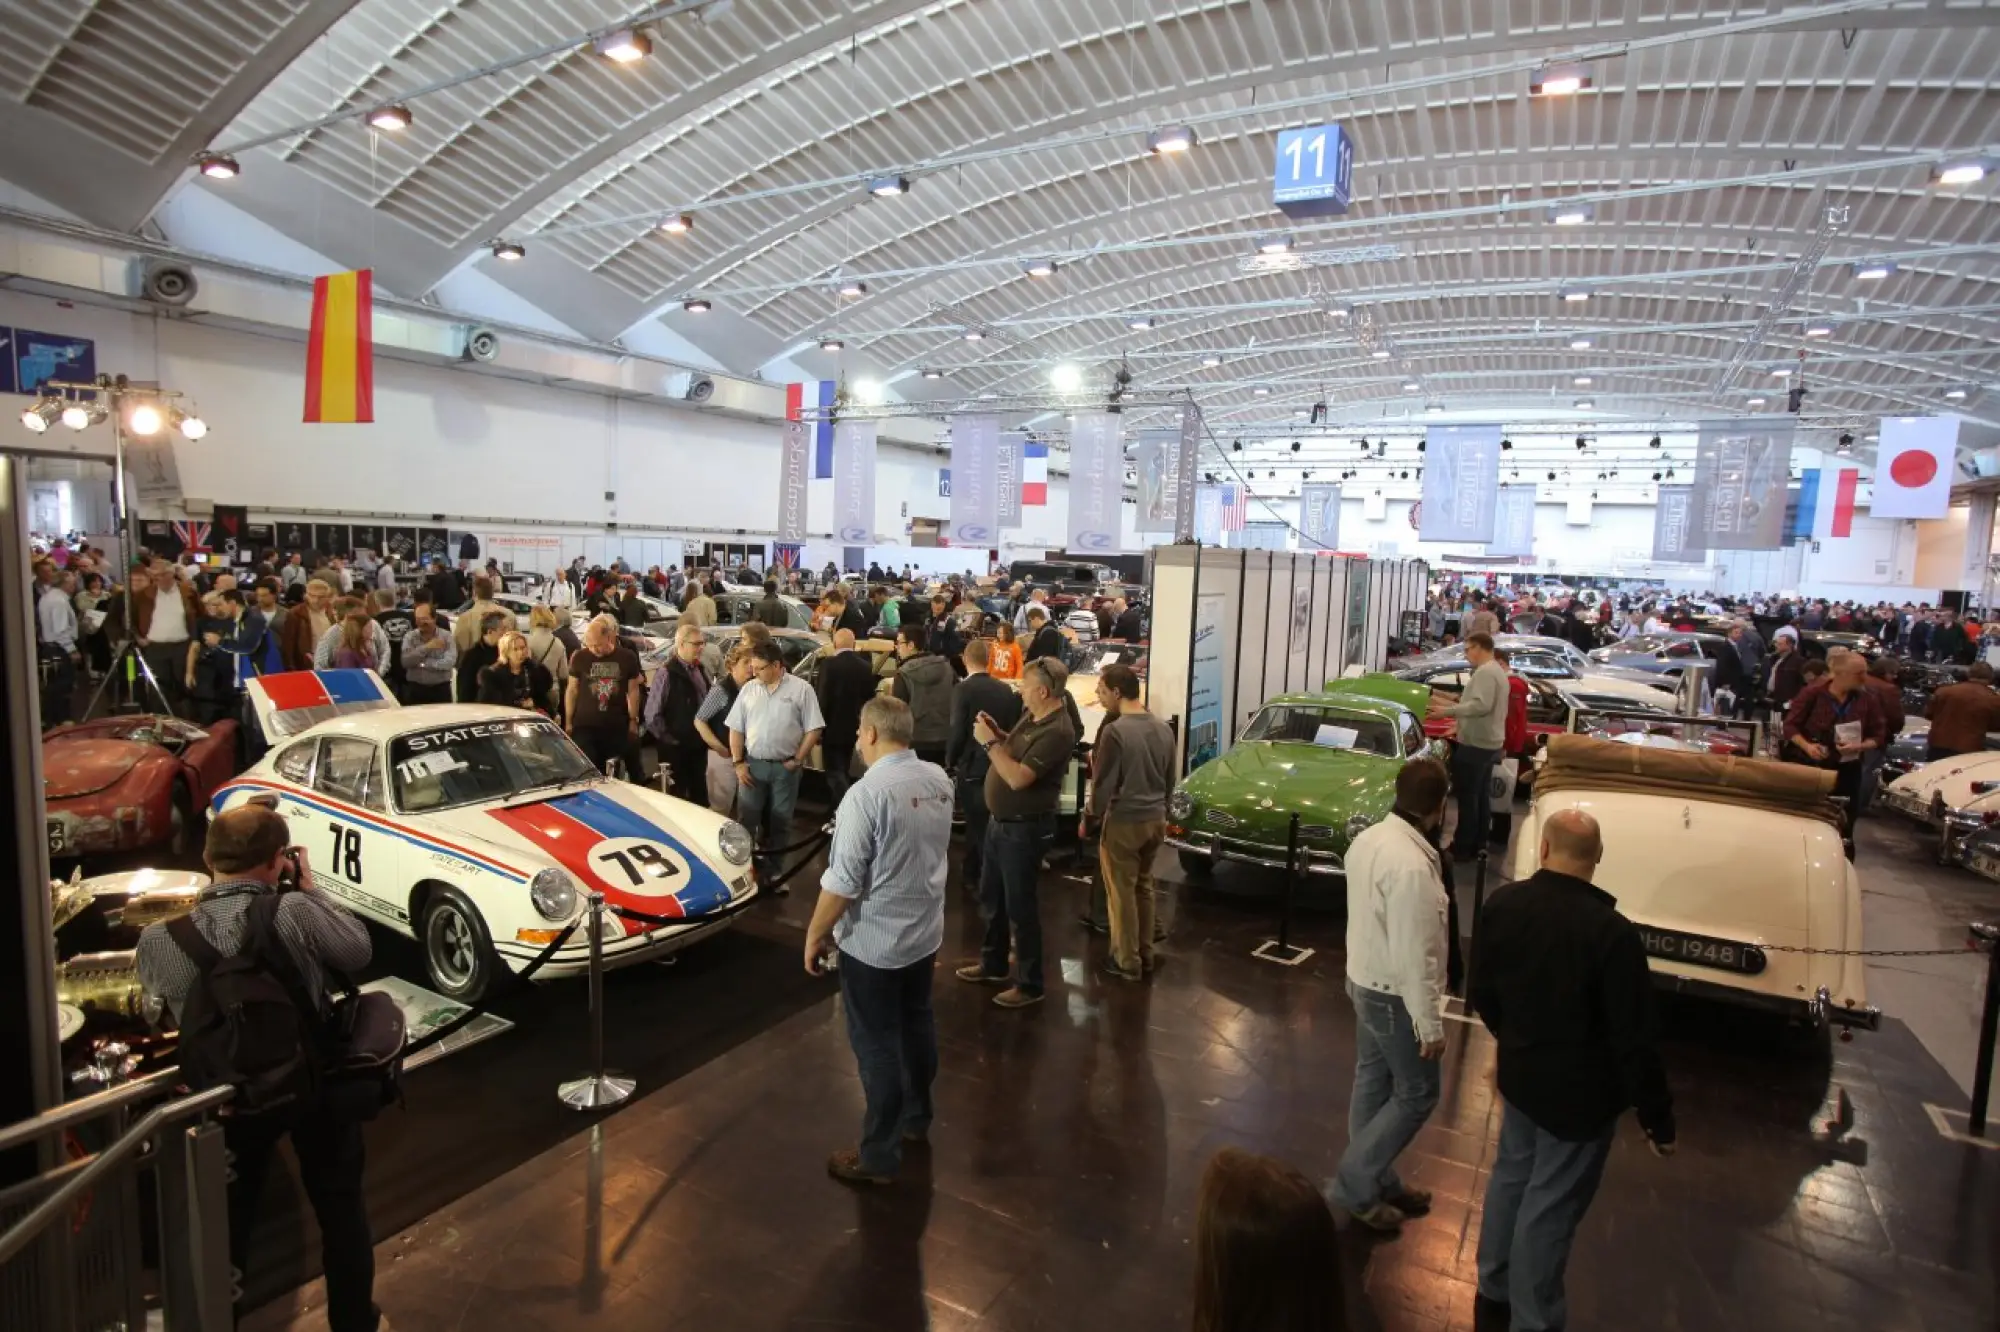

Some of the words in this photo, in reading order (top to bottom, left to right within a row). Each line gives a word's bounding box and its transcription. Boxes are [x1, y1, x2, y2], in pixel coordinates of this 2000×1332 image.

[1285, 133, 1326, 180] 11
[408, 725, 490, 750] STATE
[329, 822, 362, 884] 78
[598, 844, 680, 886] 78
[1640, 931, 1675, 952] HC
[1682, 939, 1734, 963] 1948
